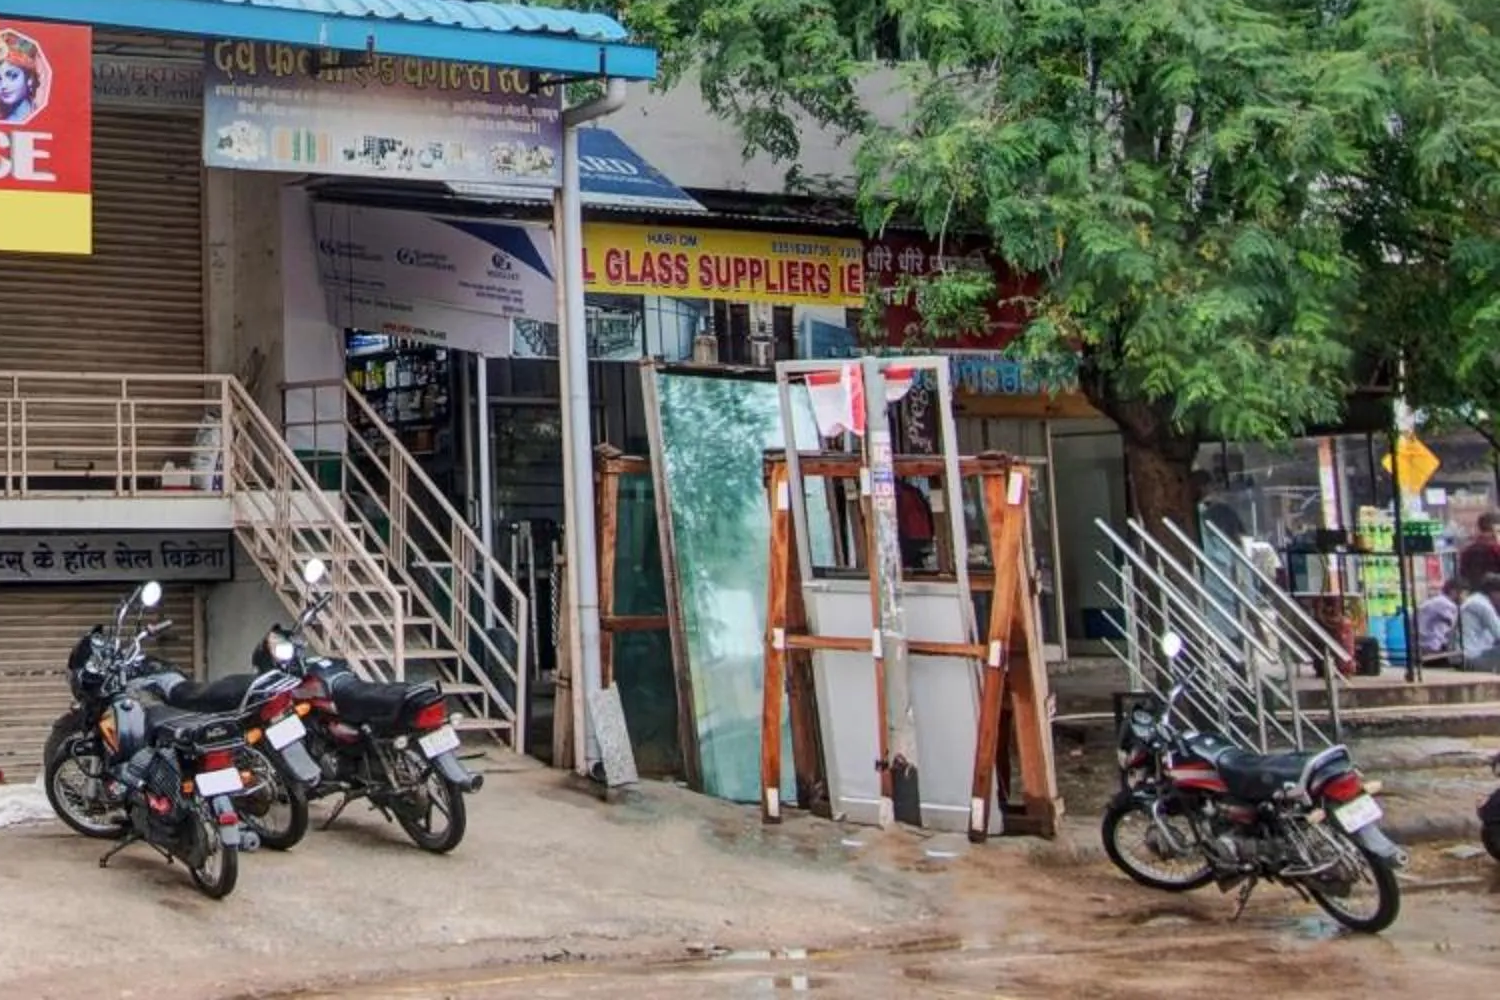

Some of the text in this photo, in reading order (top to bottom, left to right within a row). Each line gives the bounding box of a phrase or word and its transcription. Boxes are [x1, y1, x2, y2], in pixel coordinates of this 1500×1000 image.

[646, 232, 677, 246] HARI
[680, 234, 698, 247] OM
[606, 248, 690, 286] GLASS
[699, 255, 831, 294] SUPPLIERS
[32, 541, 55, 569] के
[63, 543, 107, 574] हॉल
[114, 541, 154, 570] सेल
[161, 540, 226, 569] विक्रेता
